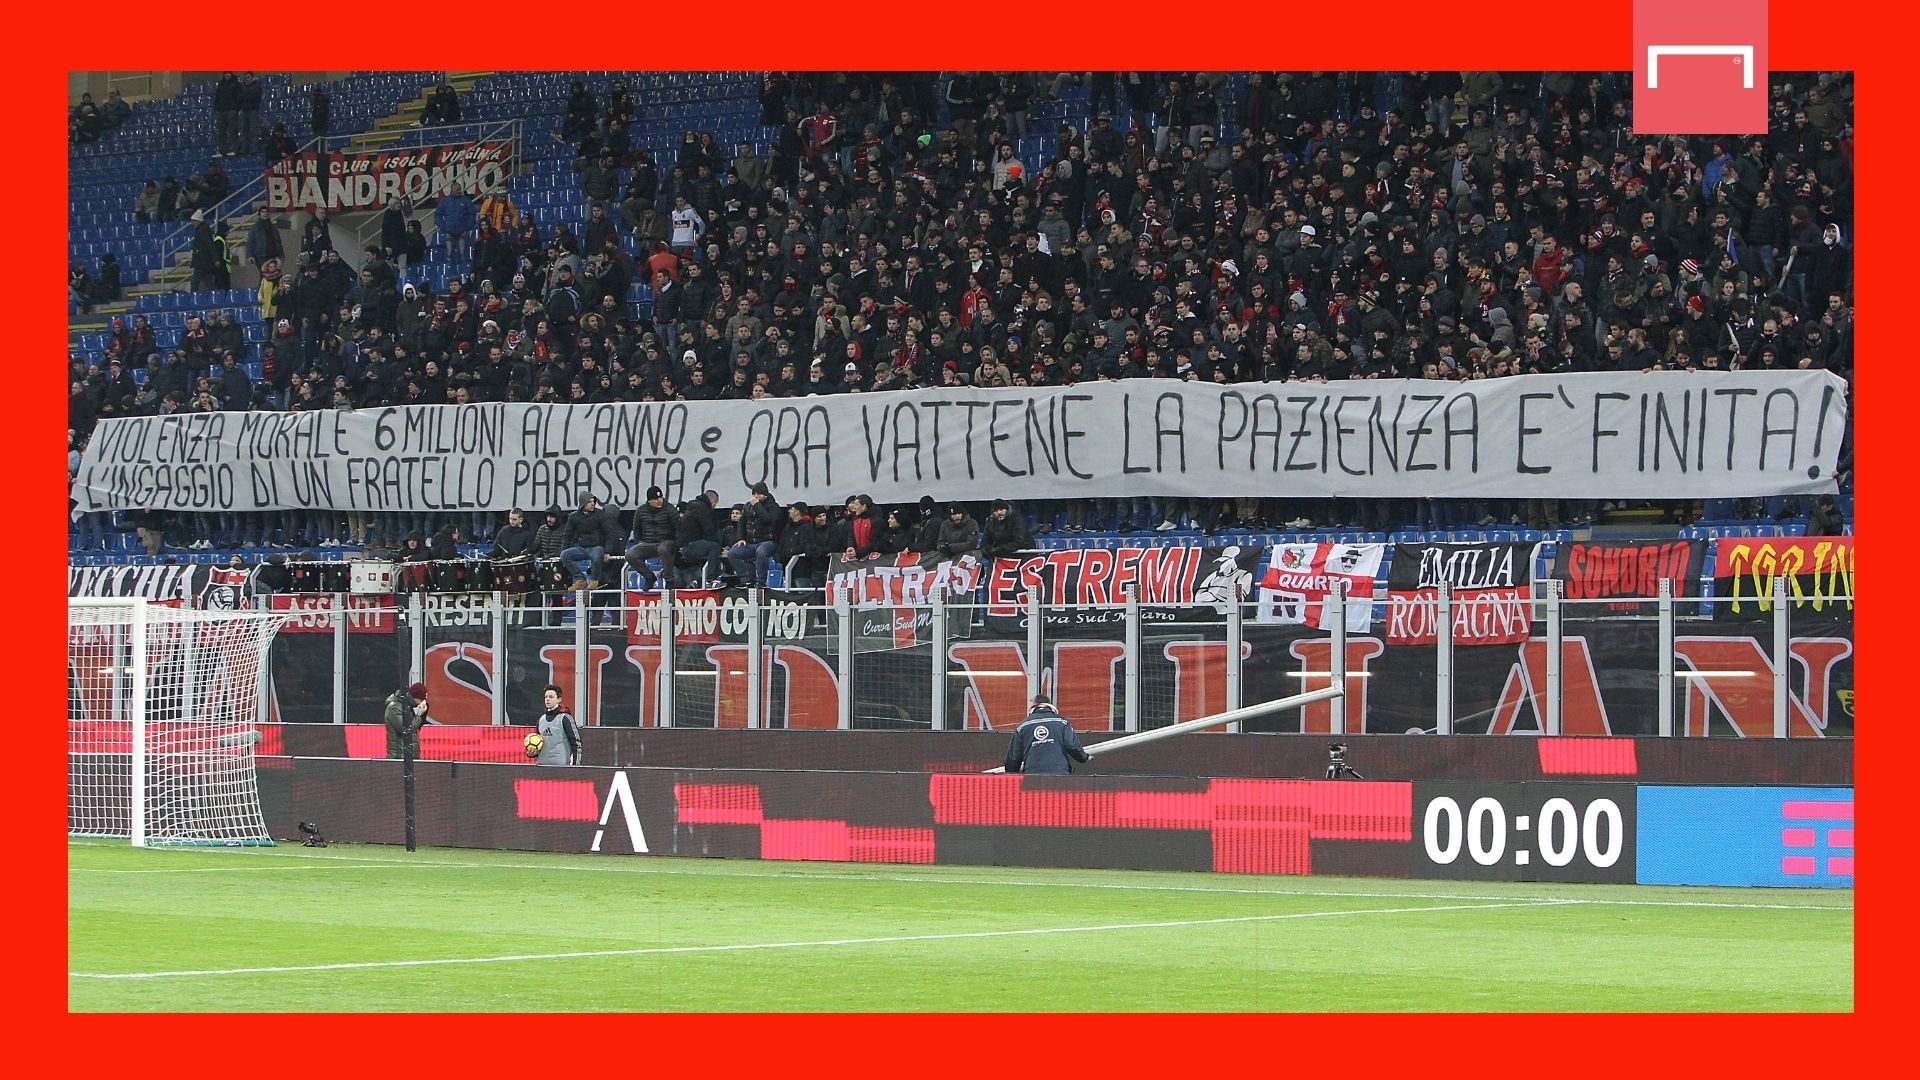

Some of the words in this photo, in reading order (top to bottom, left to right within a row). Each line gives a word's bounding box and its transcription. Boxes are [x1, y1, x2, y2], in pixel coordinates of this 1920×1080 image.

[268, 162, 504, 208] BIANDRONNO
[274, 159, 317, 175] MILAN
[330, 160, 369, 175] CLUB
[384, 153, 428, 170] ISOLA
[98, 414, 226, 464] VIOLENZA
[236, 412, 350, 460] MORALE
[522, 403, 689, 458] ALL'ANNO
[700, 426, 723, 453] e
[740, 405, 832, 490] ORA
[862, 393, 1094, 483] VATTENE
[1122, 392, 1187, 474] LA
[1218, 390, 1479, 476] PAZIENZA
[1592, 384, 1836, 480] FINITA!
[86, 463, 235, 510] L'INGAGGIO
[249, 461, 279, 507] DI
[289, 460, 331, 508] UN
[347, 456, 495, 510] FRATELLO
[833, 554, 977, 615] ULTRAS
[987, 546, 1203, 617] ESTREMI
[1416, 546, 1514, 590] EMILIA
[1566, 541, 1691, 599] SONDRIO
[1729, 541, 1854, 614] TORIN
[286, 597, 381, 628] ASSNTI
[634, 596, 718, 637] ANONIO
[863, 619, 891, 636] Curva
[894, 617, 915, 632] Sud
[1075, 611, 1109, 624] Sud
[1423, 796, 1624, 868] 00:00
